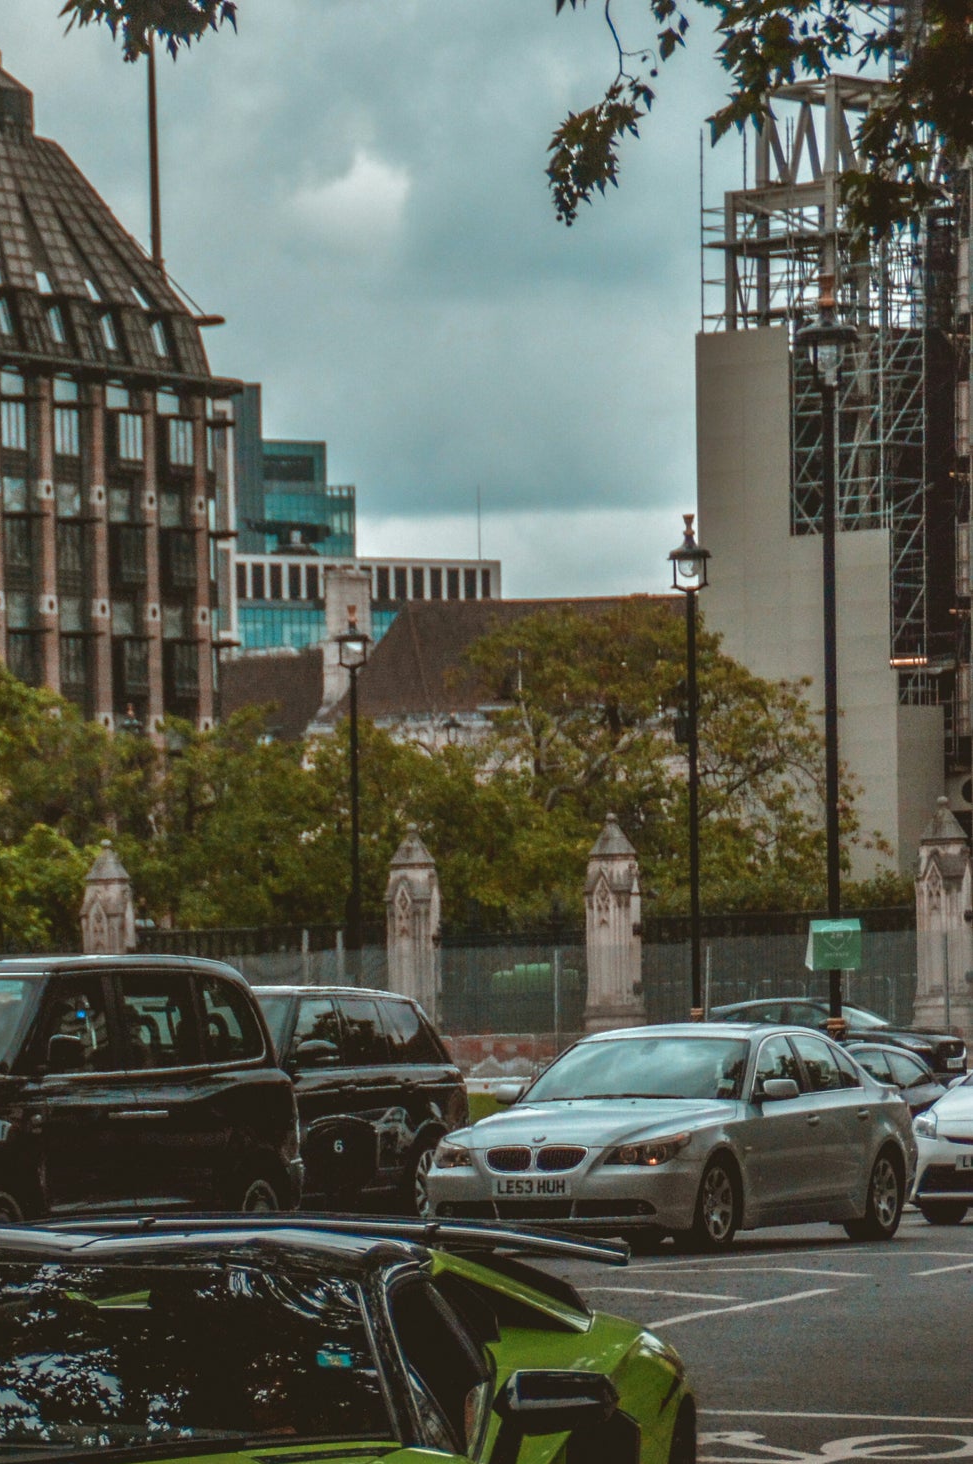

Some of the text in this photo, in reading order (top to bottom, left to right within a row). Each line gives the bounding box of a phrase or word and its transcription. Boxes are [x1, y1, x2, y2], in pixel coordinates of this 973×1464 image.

[334, 1140, 343, 1152] 6
[497, 1179, 566, 1194] LE53 HUH
